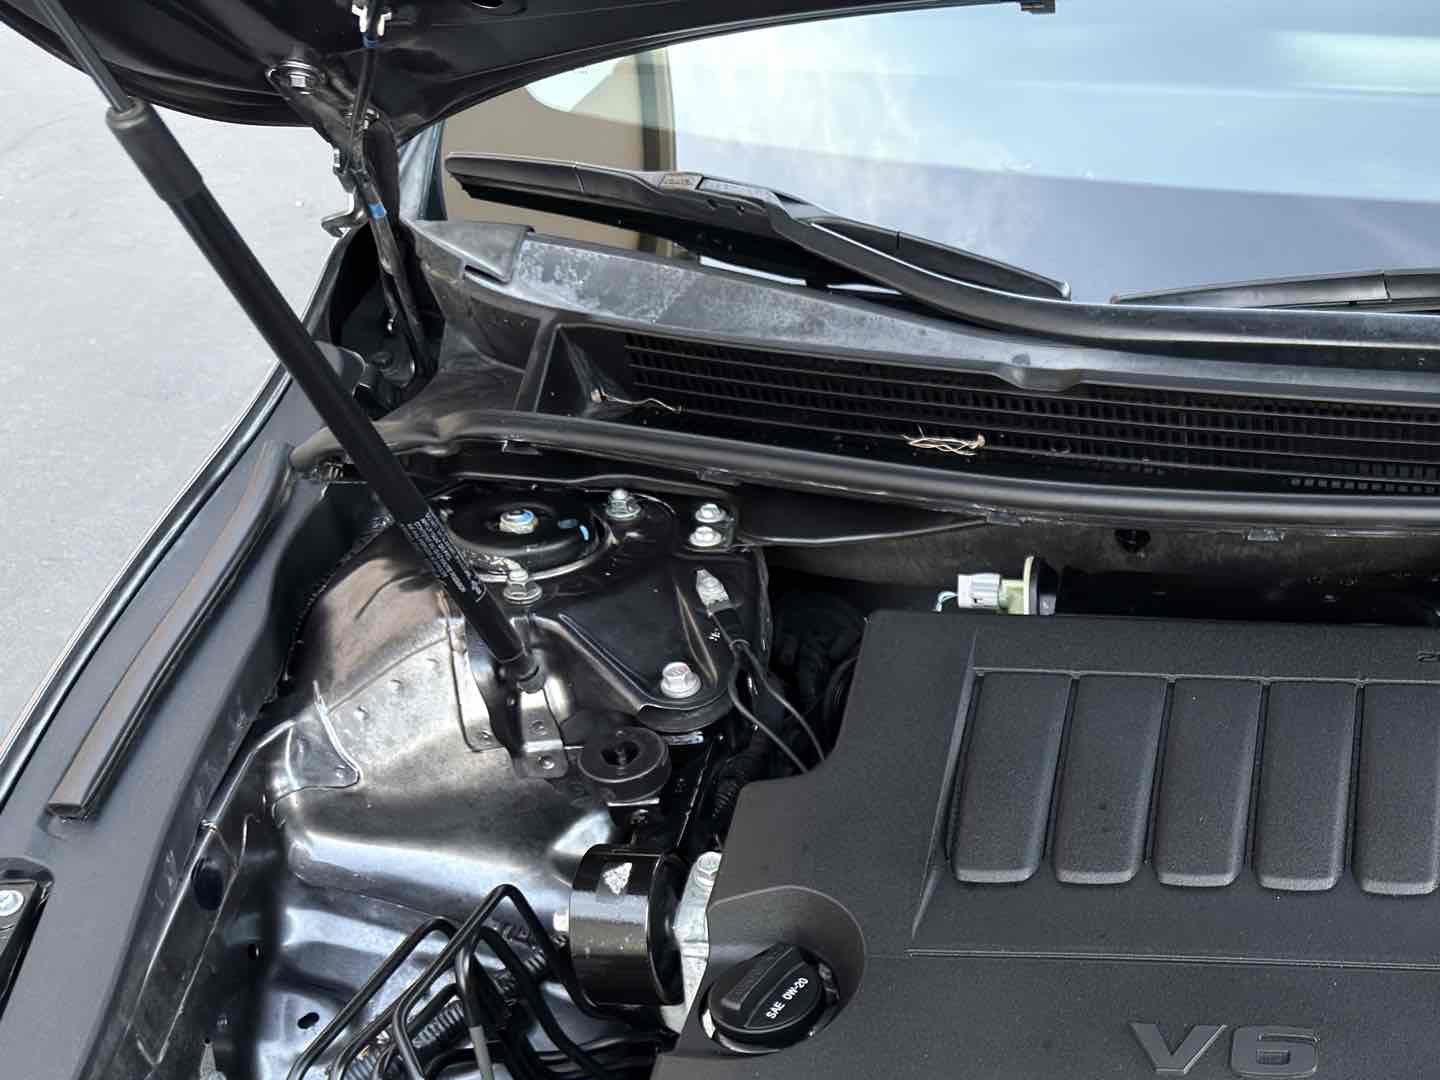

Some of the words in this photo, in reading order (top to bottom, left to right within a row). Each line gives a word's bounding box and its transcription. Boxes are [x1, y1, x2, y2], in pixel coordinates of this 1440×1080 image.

[765, 1001, 785, 1019] SAE
[781, 977, 809, 1000] 0W-20
[1129, 1022, 1321, 1078] V6
